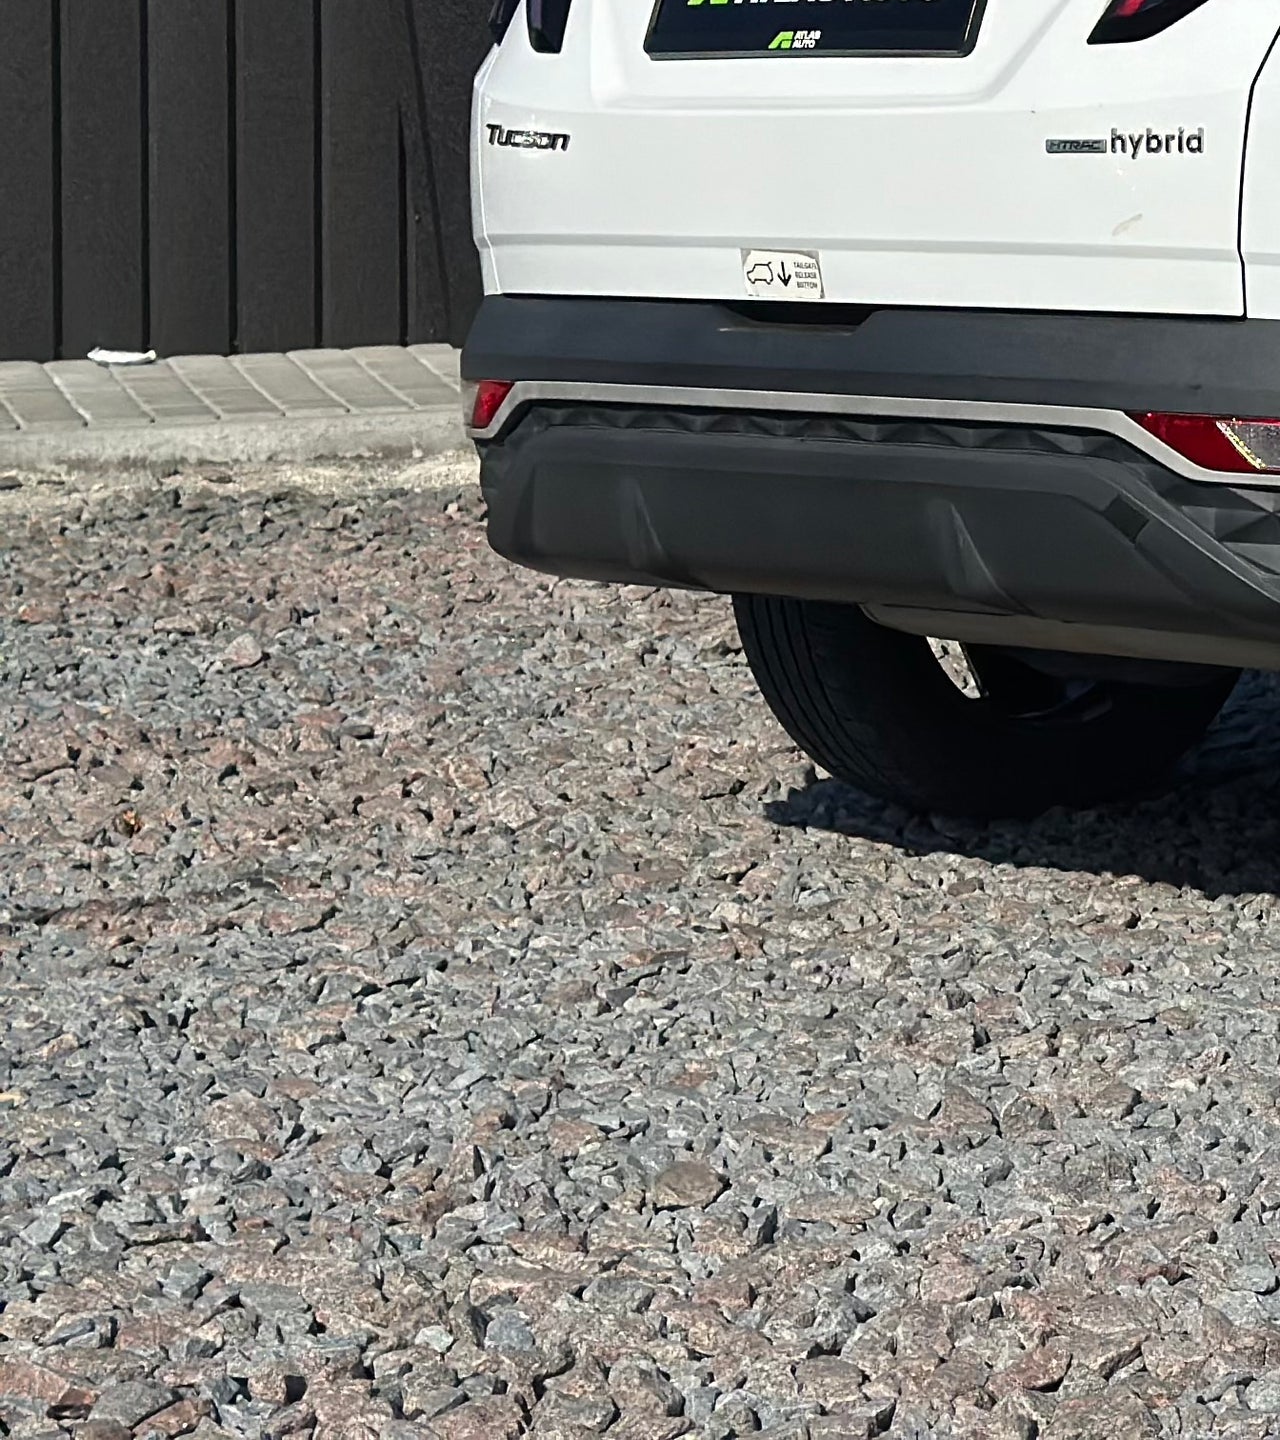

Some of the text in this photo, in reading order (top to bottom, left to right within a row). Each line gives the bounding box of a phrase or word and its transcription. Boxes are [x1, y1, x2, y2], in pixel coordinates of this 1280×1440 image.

[793, 30, 822, 40] ATLAS
[791, 39, 816, 49] AUTO
[1110, 126, 1205, 160] hybrid
